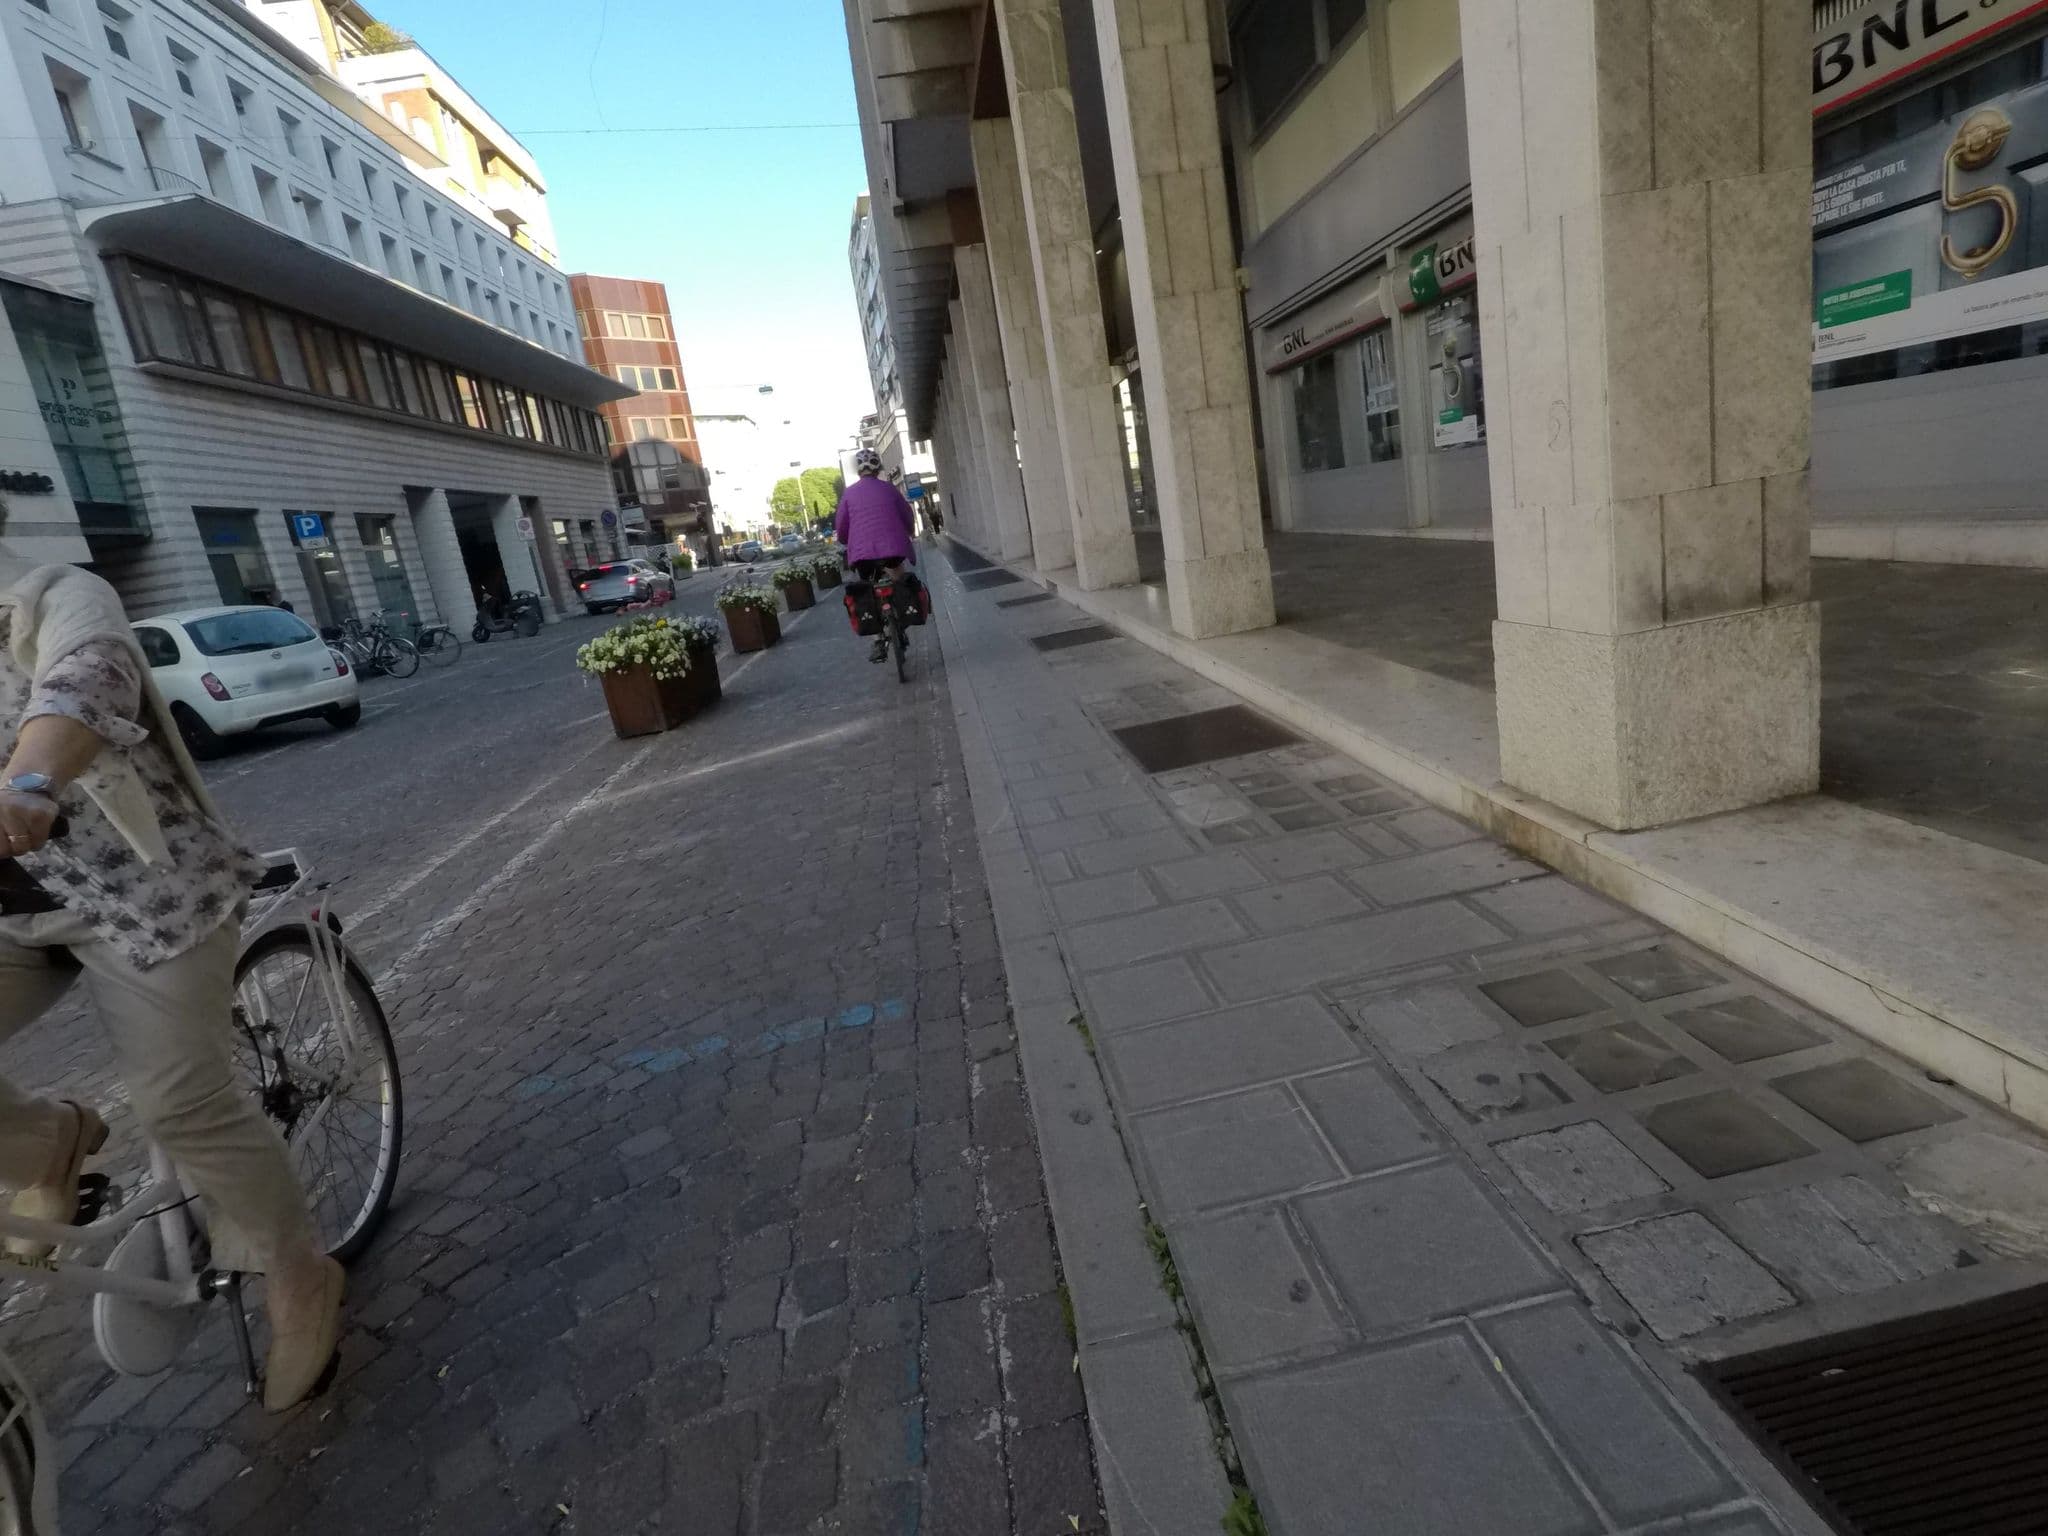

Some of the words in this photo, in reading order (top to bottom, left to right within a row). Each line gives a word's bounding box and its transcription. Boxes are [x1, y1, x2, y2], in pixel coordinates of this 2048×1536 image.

[1813, 0, 1969, 94] BNL
[1439, 236, 1474, 278] BN
[300, 517, 316, 537] P
